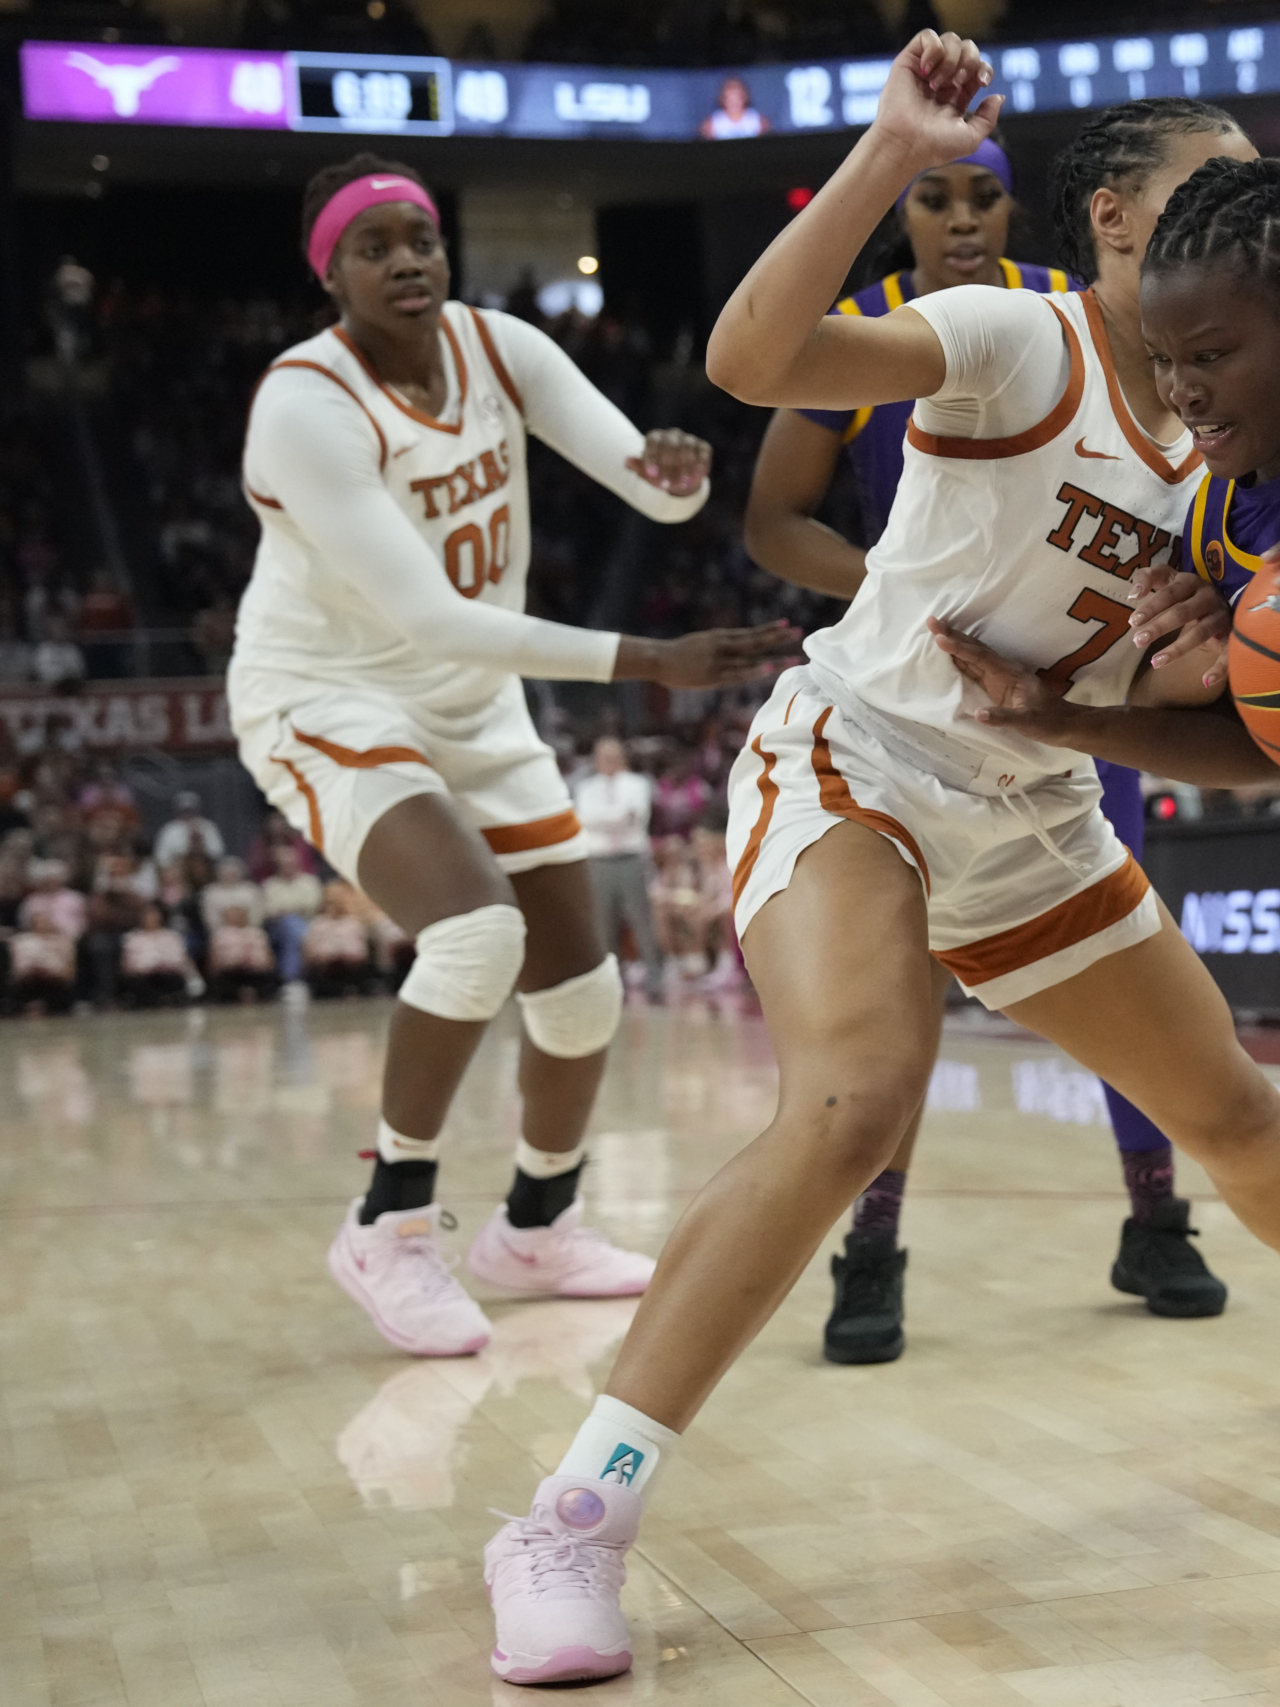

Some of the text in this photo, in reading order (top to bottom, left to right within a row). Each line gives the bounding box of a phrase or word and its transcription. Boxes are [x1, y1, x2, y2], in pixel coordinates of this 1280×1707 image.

[554, 81, 650, 123] LSU
[785, 66, 833, 127] 12
[1035, 586, 1136, 697] 7
